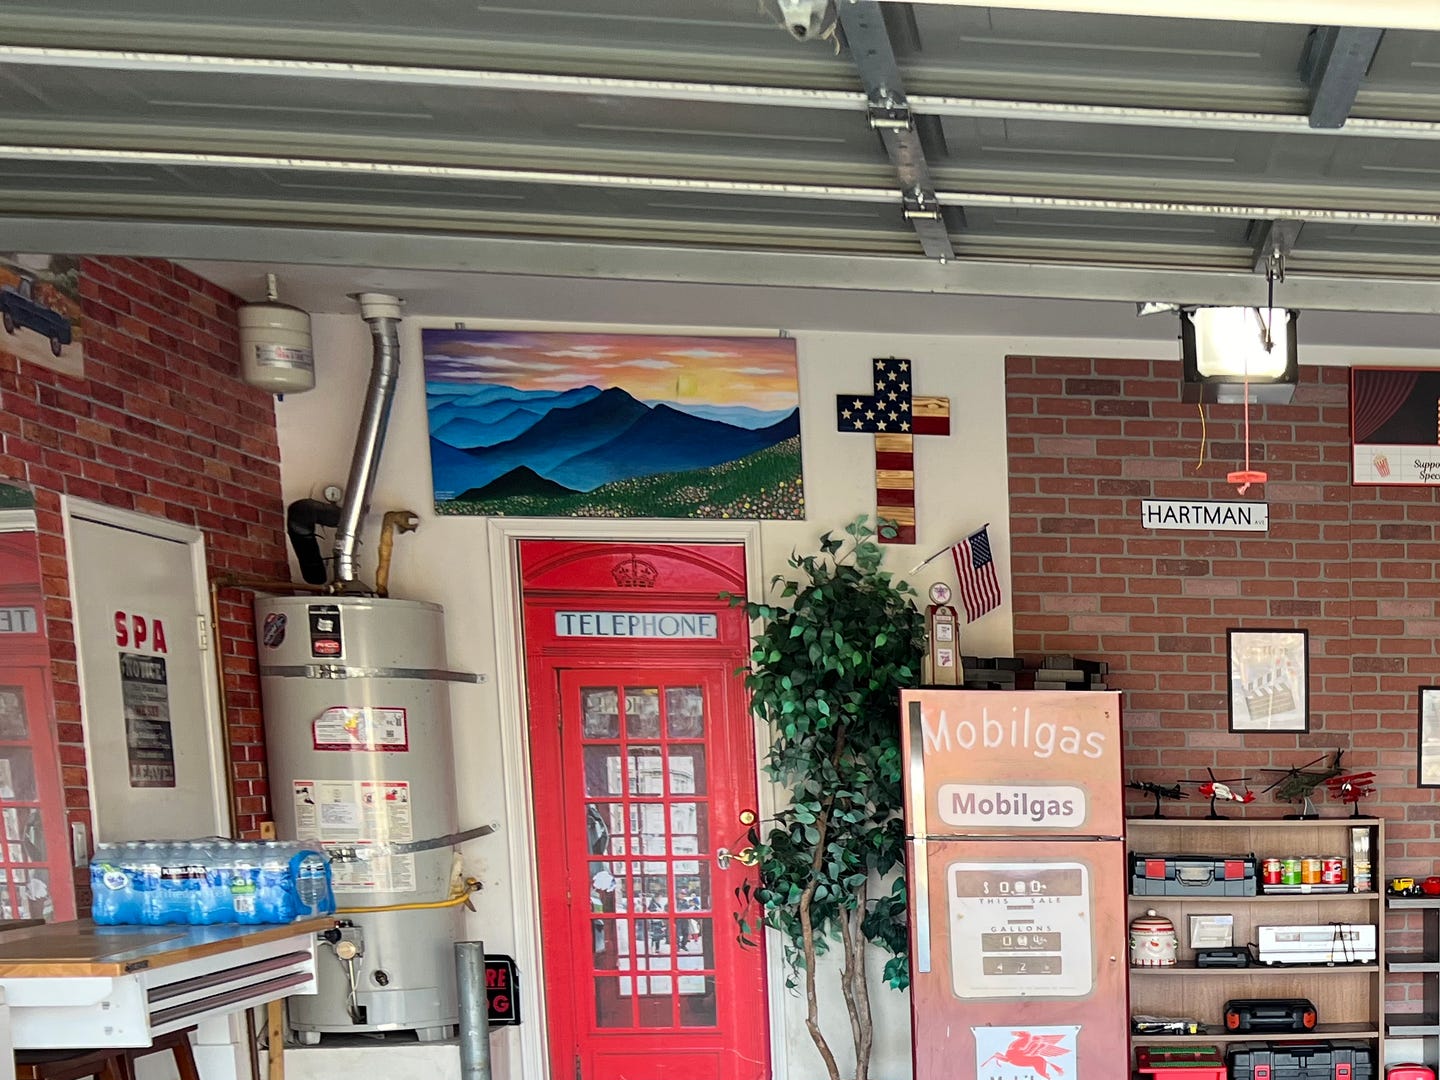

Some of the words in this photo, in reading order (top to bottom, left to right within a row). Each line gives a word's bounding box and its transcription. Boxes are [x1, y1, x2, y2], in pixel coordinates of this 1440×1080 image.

[1148, 504, 1252, 525] HARTMAN
[114, 610, 168, 654] SPA
[561, 613, 713, 637] TELEPHONE
[920, 706, 1106, 758] Mobilgas
[952, 792, 1074, 822] Mobilgas
[1031, 897, 1061, 905] SALE
